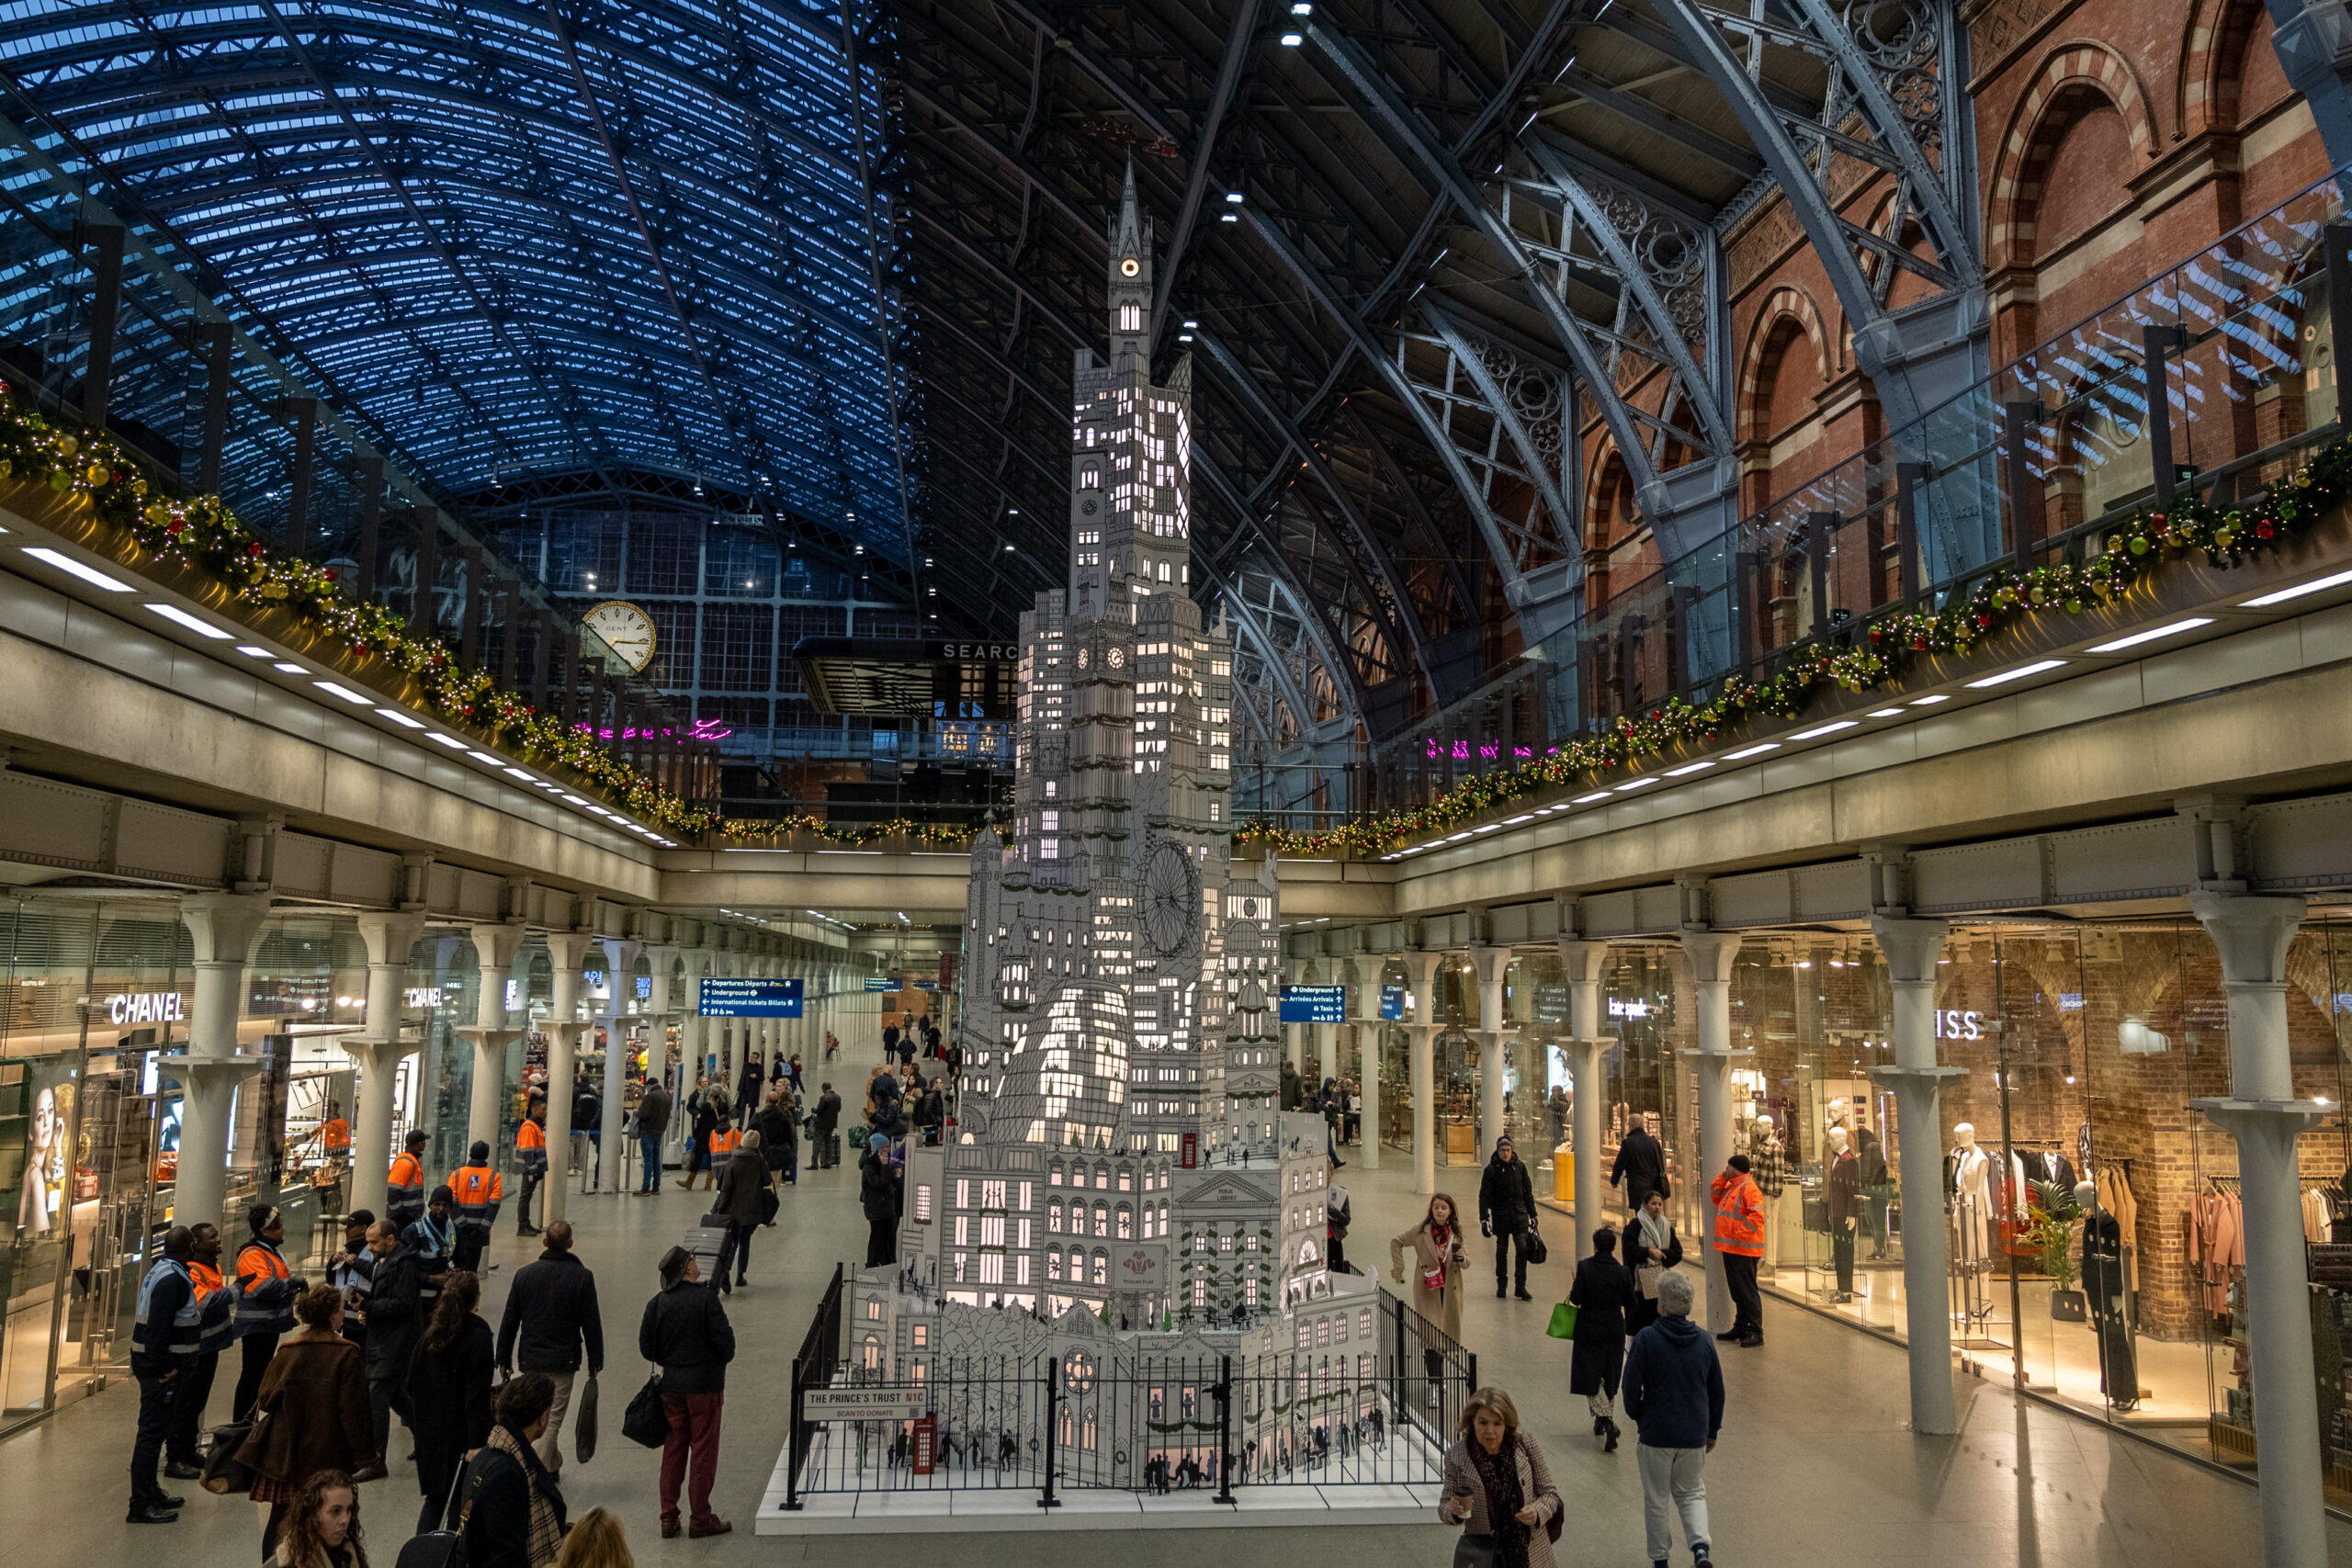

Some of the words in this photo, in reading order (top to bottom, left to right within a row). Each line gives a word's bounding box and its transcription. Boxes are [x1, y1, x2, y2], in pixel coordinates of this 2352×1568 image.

[943, 644, 1018, 660] SEARC
[711, 979, 744, 987] Departures
[744, 979, 767, 987] Départs
[711, 989, 749, 998] Underground
[1298, 986, 1334, 995] Underground
[409, 987, 443, 1009] CHANEL
[710, 998, 748, 1007] International
[748, 998, 768, 1007] tickets
[768, 998, 786, 1007] Billets
[111, 992, 184, 1025] CHANEL
[809, 1393, 827, 1404] THE
[829, 1393, 870, 1404] PRINCE'S
[872, 1393, 901, 1403] TRUST
[905, 1392, 924, 1403] N1C
[866, 1409, 894, 1417] DONATE
